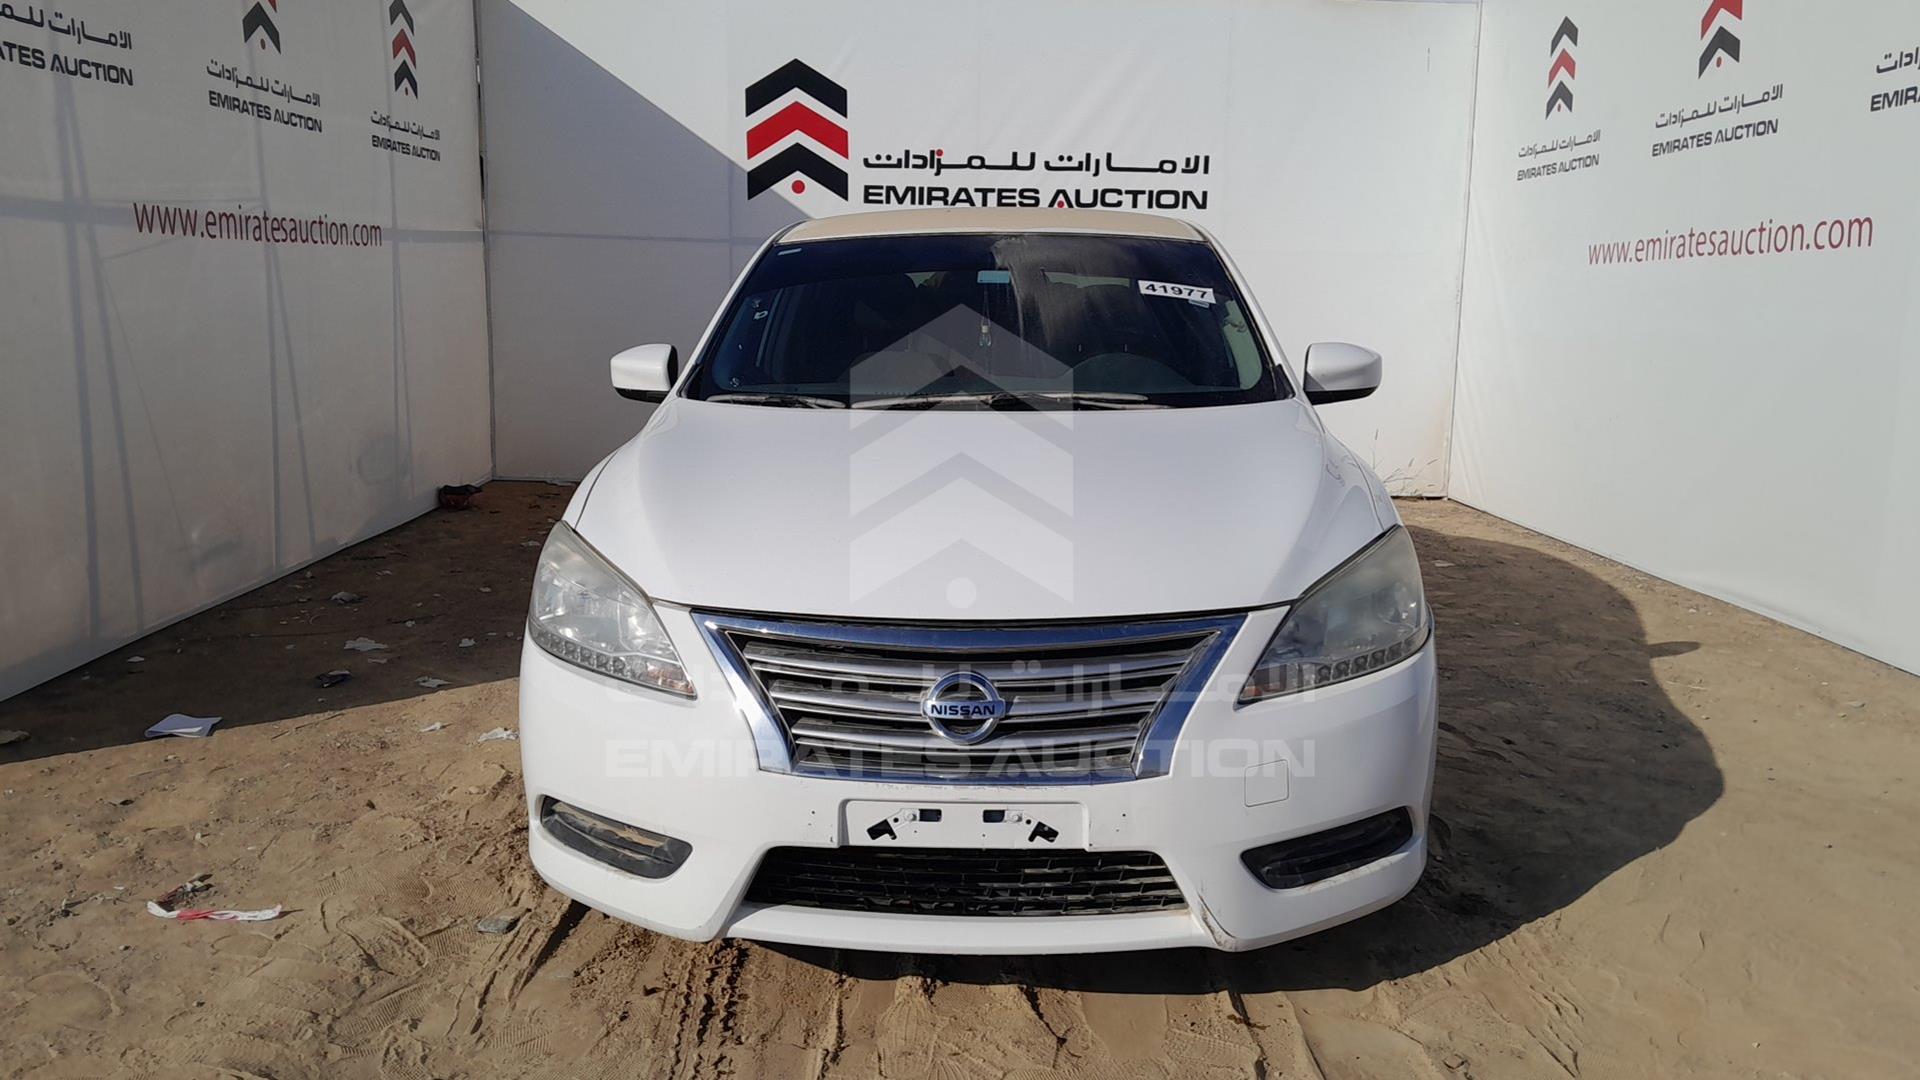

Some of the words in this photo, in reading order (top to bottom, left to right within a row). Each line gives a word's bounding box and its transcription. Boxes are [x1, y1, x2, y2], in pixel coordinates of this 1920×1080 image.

[50, 54, 134, 86] AUCTION
[208, 90, 272, 121] EMIRATES
[273, 108, 323, 133] AUCTION
[1870, 86, 1920, 112] EMIR
[371, 134, 411, 155] EMIRATES
[412, 144, 441, 162] AUCTION
[1651, 131, 1713, 157] EMIRATES
[1714, 118, 1779, 145] AUCTION
[1516, 162, 1558, 181] EMIRATES
[1558, 153, 1600, 173] AUCTION
[863, 184, 1040, 208] EMIRATES
[1047, 189, 1208, 210] AUCTION
[133, 202, 383, 248] www.emiratesauction.com
[1588, 215, 1874, 266] www.emiratesauction.com
[1145, 283, 1208, 299] 41977
[931, 704, 995, 716] NISSAN
